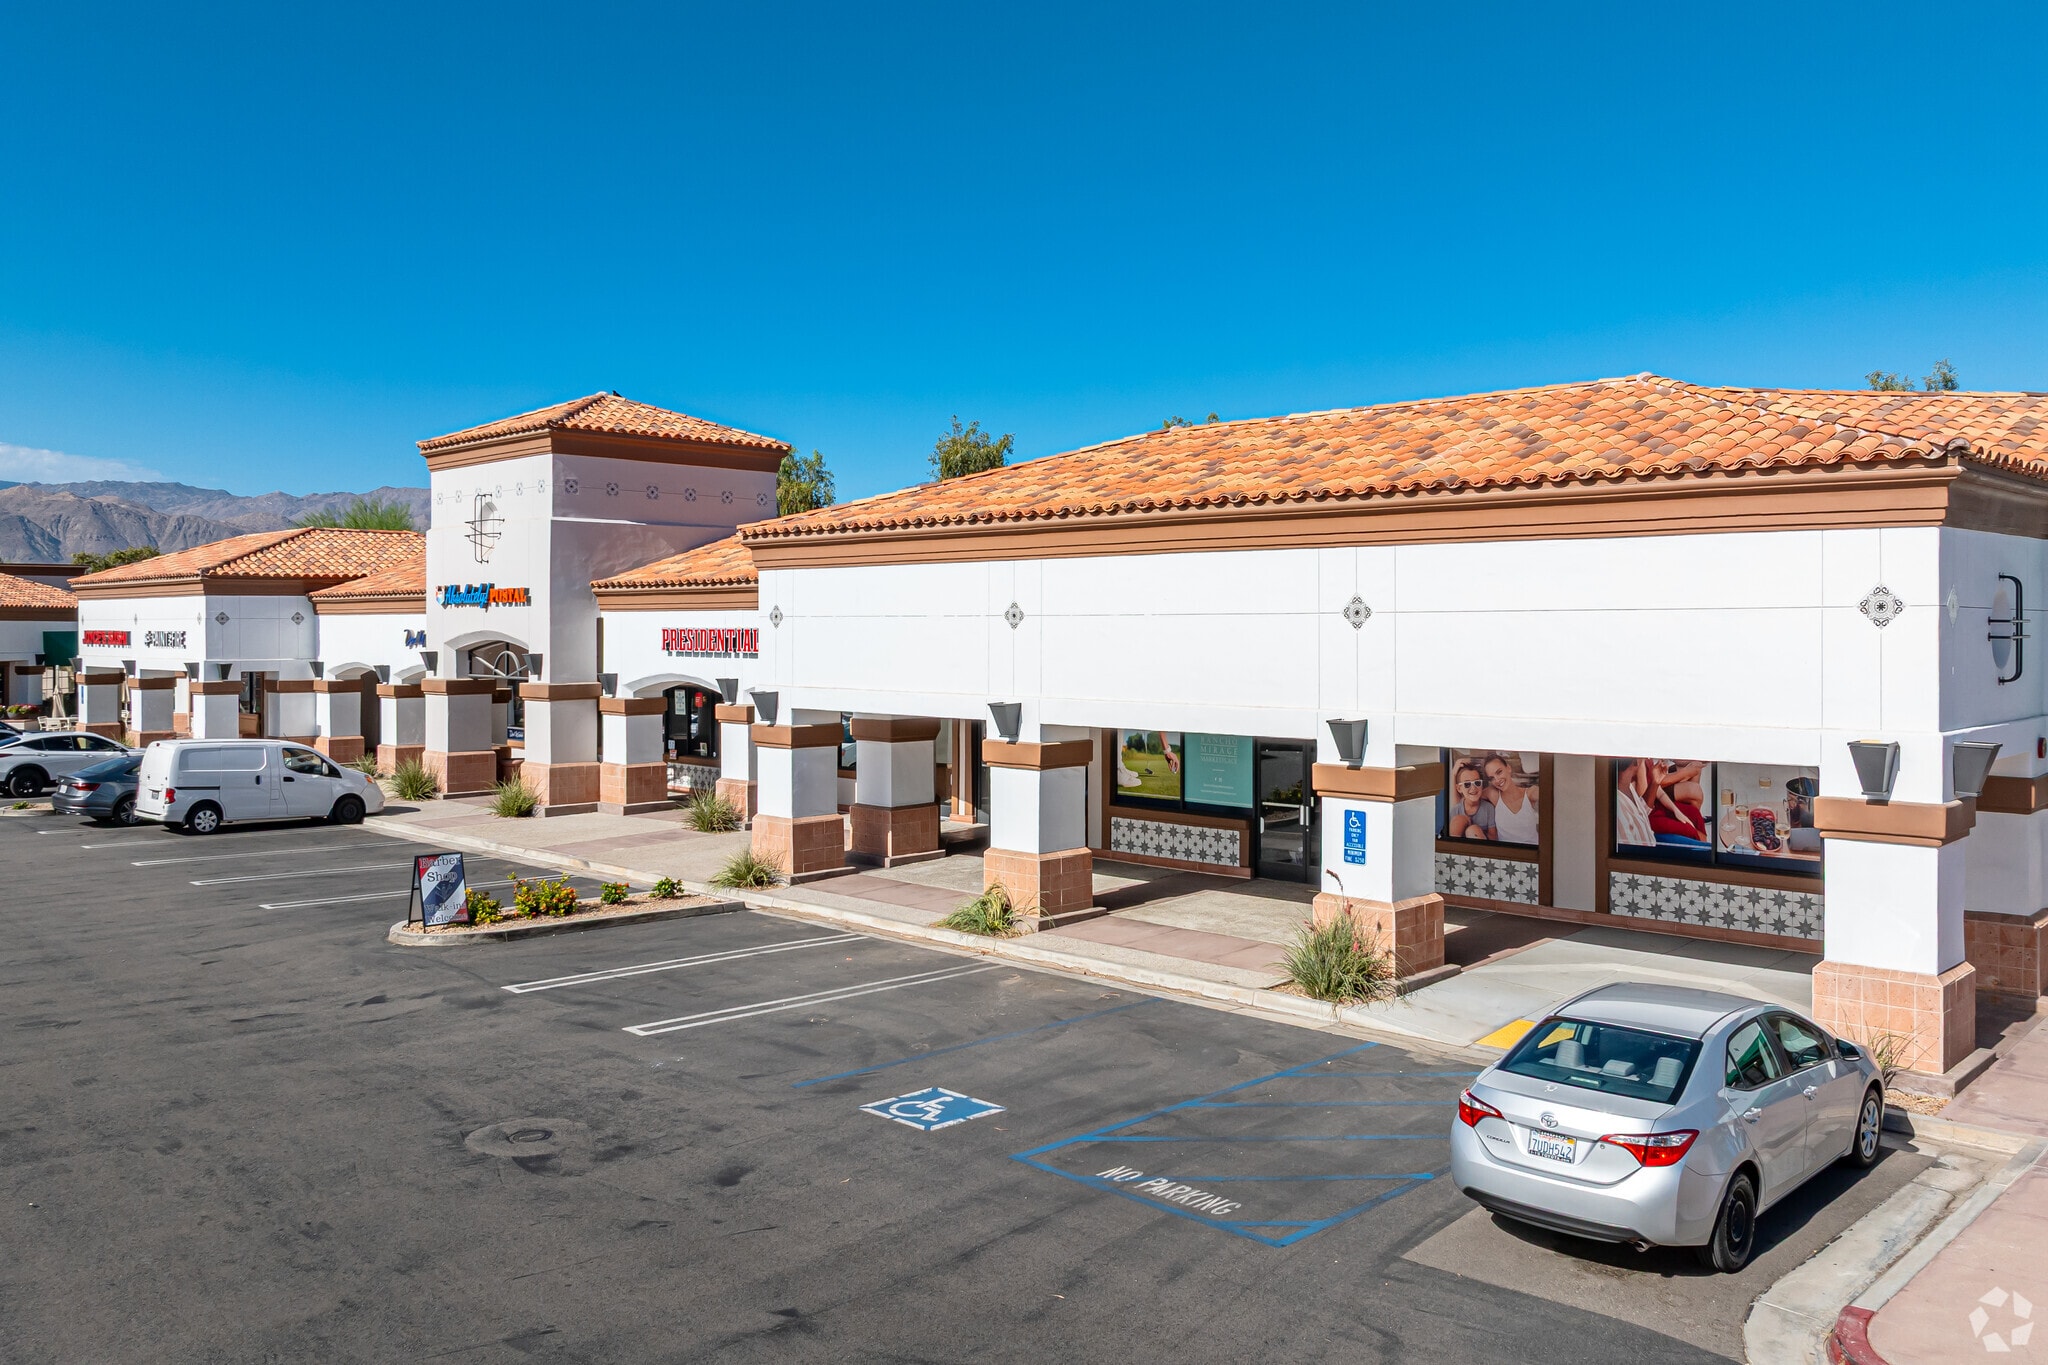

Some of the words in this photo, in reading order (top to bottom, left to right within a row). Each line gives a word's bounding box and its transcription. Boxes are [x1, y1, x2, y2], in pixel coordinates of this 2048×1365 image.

[489, 587, 527, 603] POSTAL
[661, 628, 759, 652] PRESIDENTIAL
[1200, 735, 1238, 745] RANCHO
[1200, 746, 1238, 755] MIRAGE
[419, 855, 462, 868] Barber
[427, 871, 458, 883] Shop
[1532, 1138, 1572, 1159] 7UDH542
[1095, 1165, 1144, 1182] NO
[1134, 1177, 1242, 1215] PARKING
